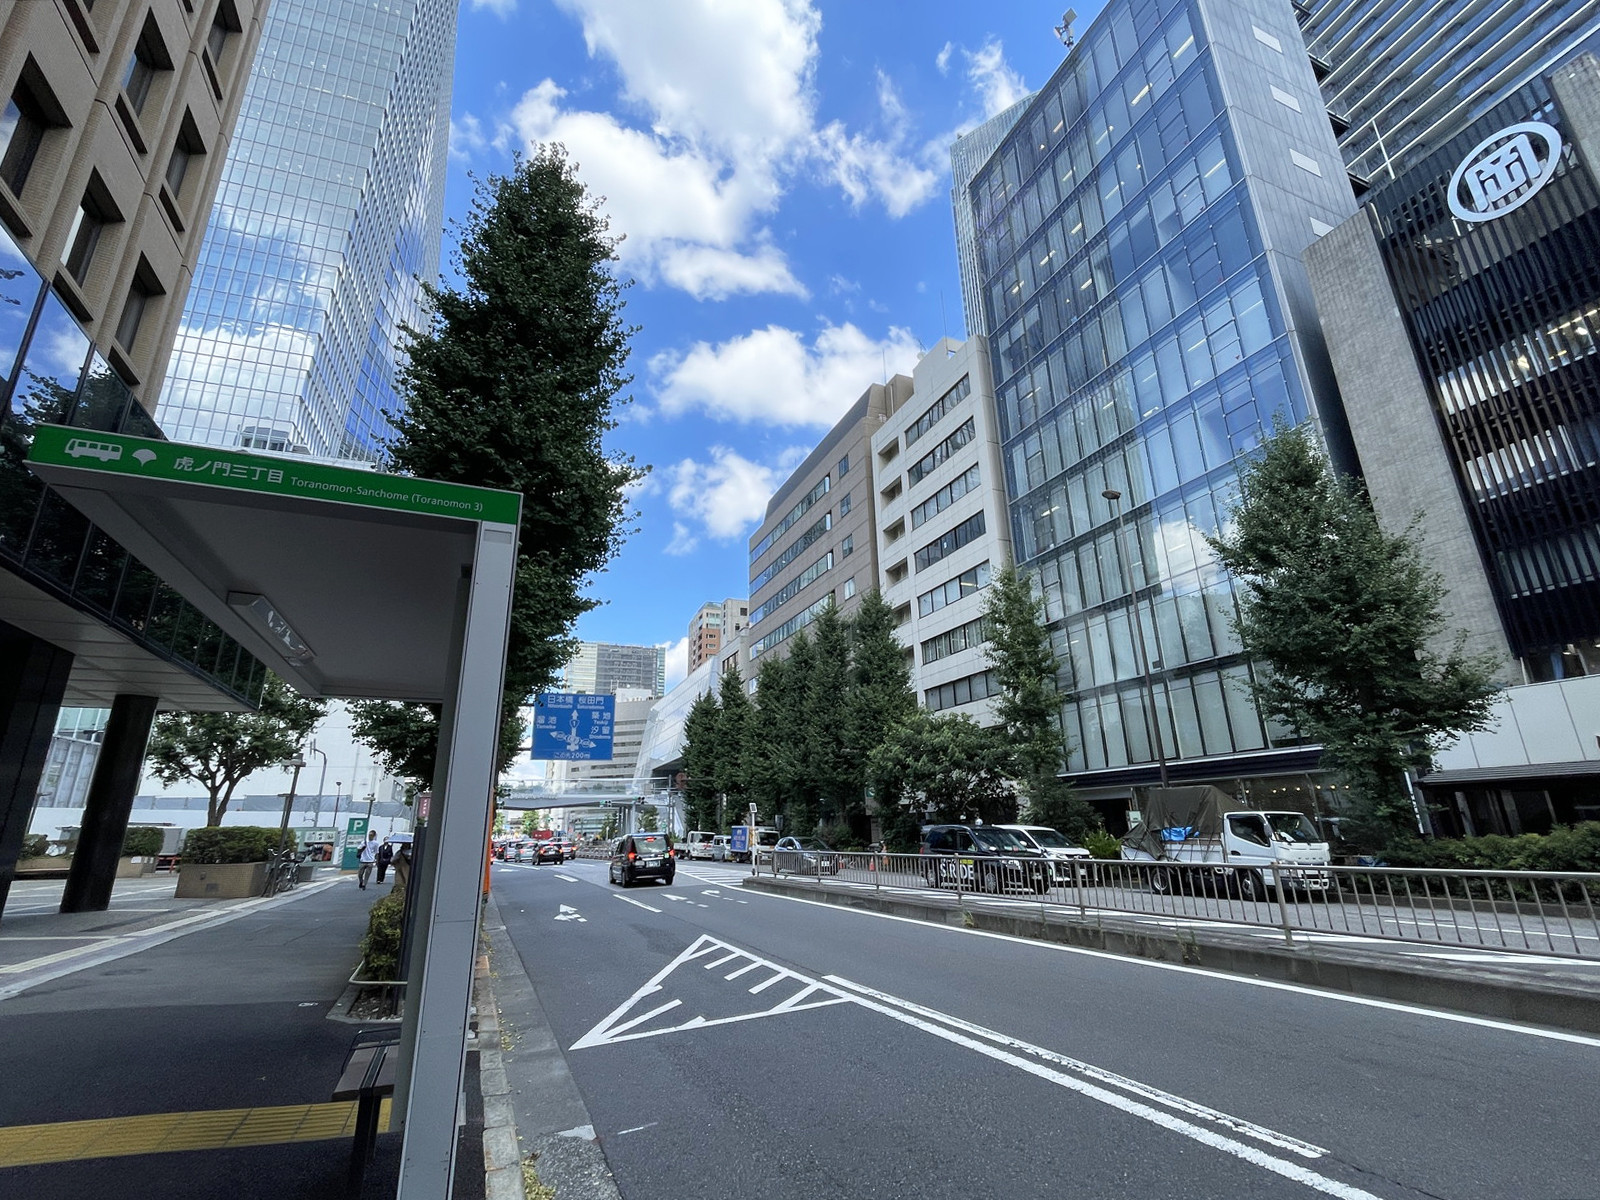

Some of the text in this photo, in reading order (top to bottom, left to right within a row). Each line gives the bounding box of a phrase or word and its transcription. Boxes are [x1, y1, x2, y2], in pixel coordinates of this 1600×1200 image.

[173, 456, 284, 484] 虎ノ門三丁目
[291, 476, 484, 512] Toranomon-Sanchome (Toranomon 3)
[353, 820, 364, 831] P
